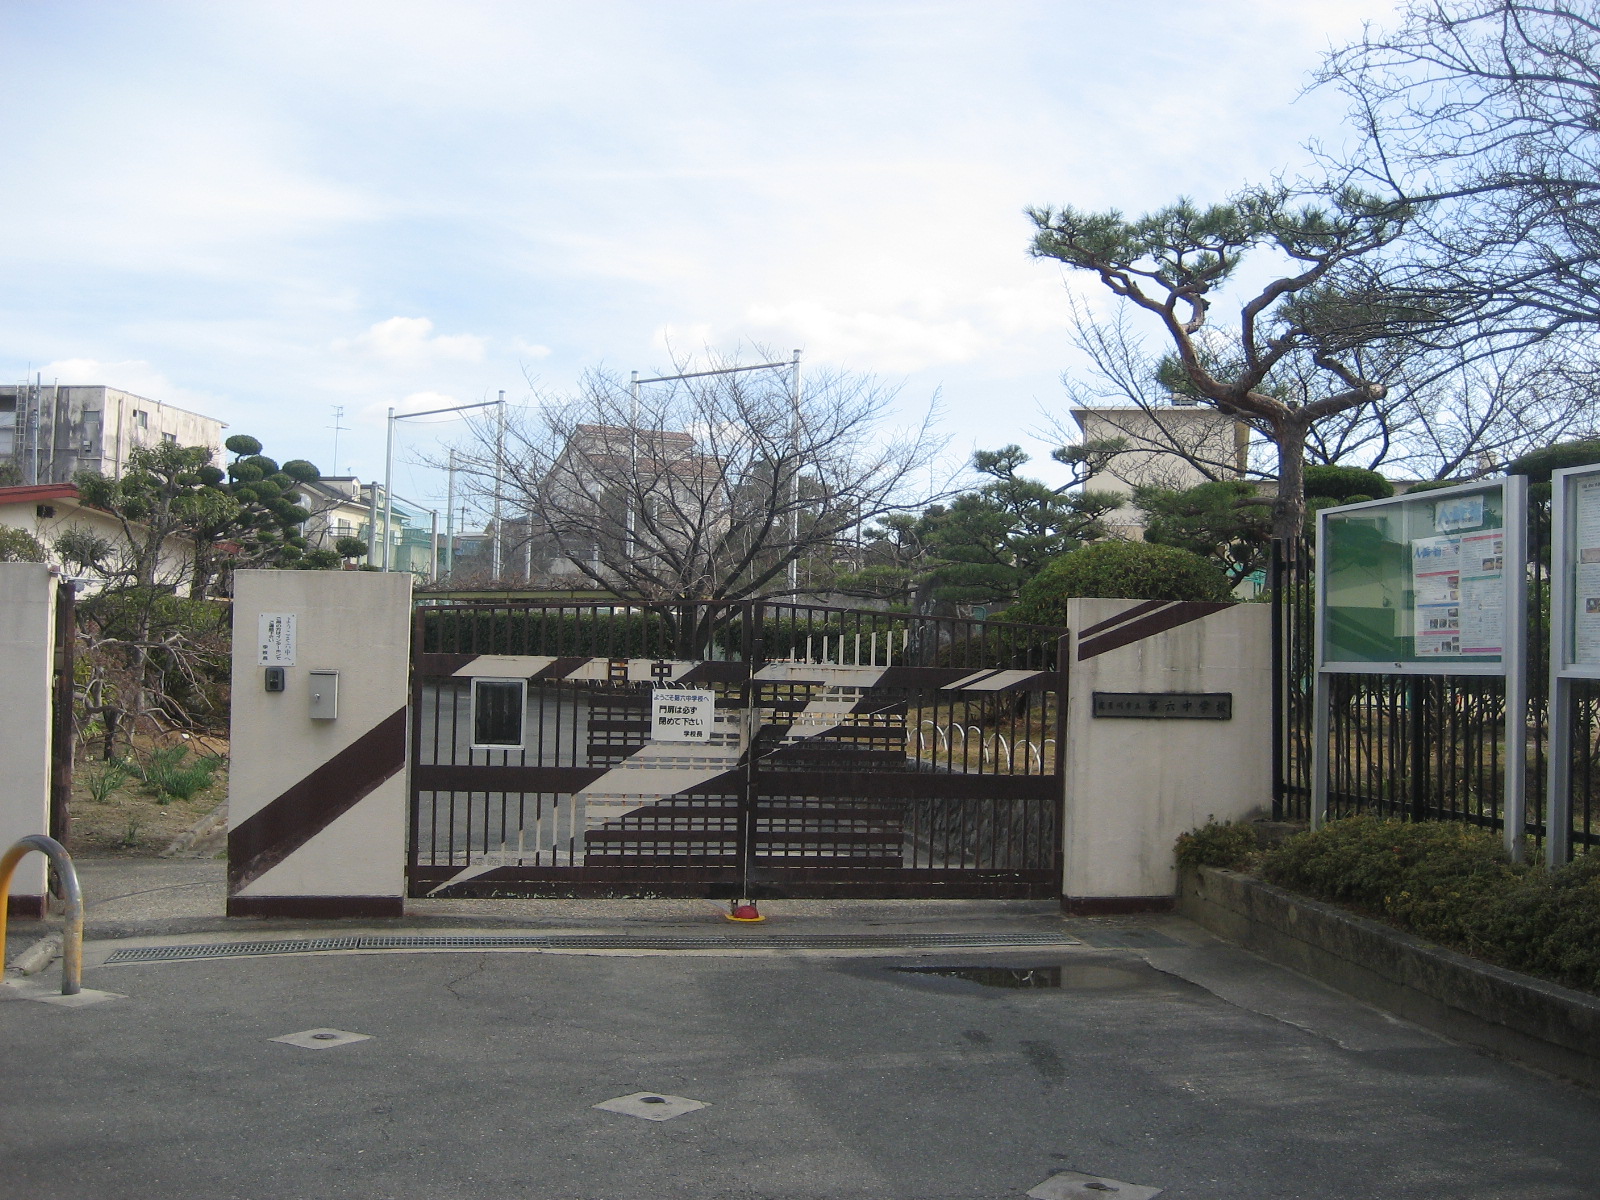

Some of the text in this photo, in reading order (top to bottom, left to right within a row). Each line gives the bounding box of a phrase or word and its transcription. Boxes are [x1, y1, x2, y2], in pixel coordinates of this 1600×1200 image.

[658, 717, 703, 726] 閉めて下さい
